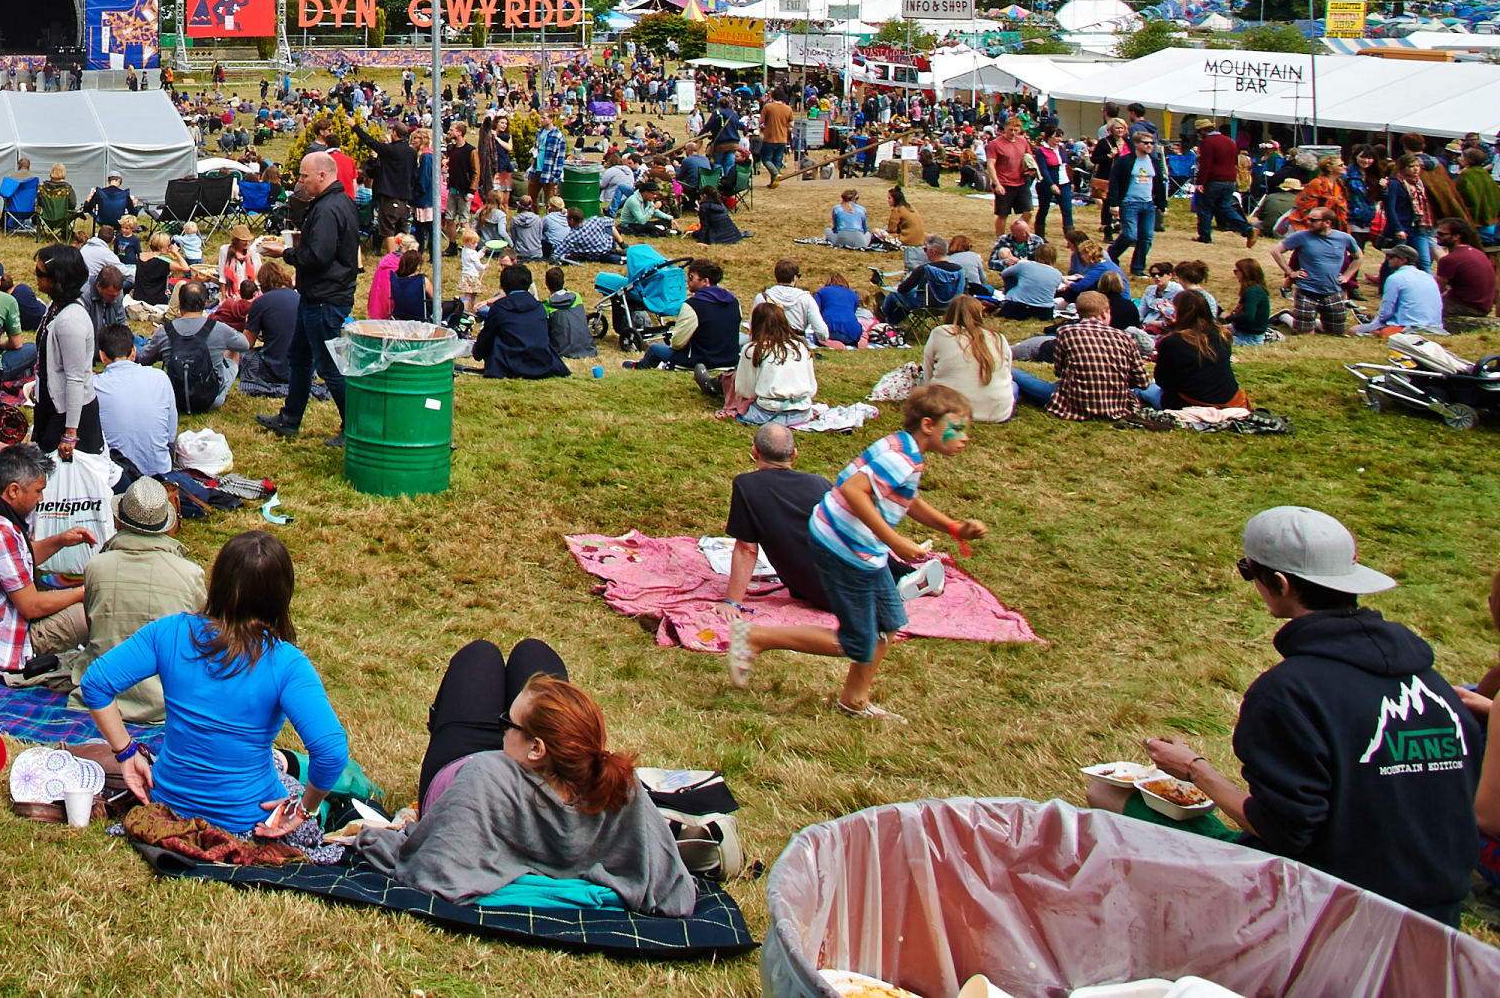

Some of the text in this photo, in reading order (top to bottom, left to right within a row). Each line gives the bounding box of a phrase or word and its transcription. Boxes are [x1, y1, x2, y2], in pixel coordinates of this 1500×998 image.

[905, 0, 968, 12] INFO & SHOP
[1333, 20, 1356, 29] SHOP
[1204, 58, 1303, 81] MOUNTAIN
[1236, 76, 1268, 94] BAR
[1385, 728, 1457, 762] VANS
[1379, 760, 1463, 775] MOUNTAIN EDITION
